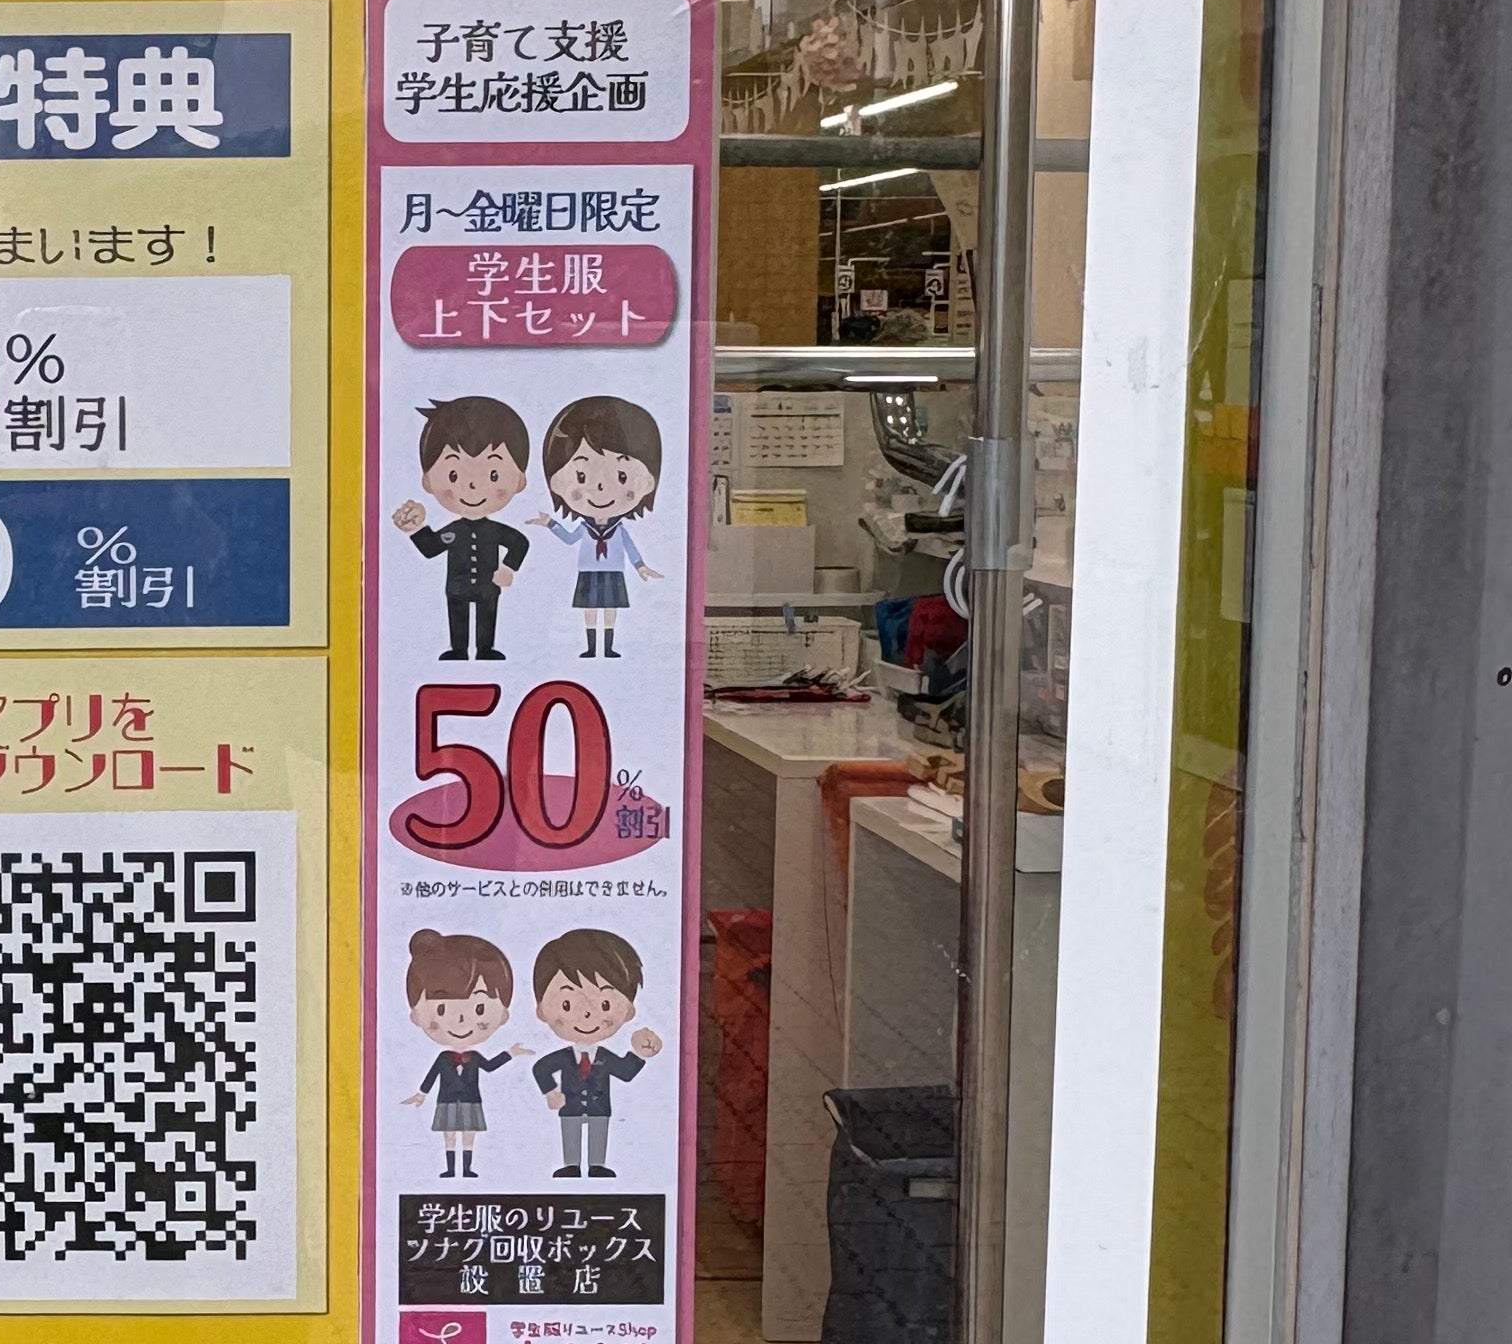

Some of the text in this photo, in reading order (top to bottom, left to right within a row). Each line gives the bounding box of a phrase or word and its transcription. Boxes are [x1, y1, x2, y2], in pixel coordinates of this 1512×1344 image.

[417, 19, 630, 63] 子育て支援
[395, 71, 649, 115] 学生応援企画
[466, 252, 607, 296] 学生服
[418, 298, 646, 340] 上下セット
[4, 395, 129, 453] 割引
[74, 565, 196, 610] 割引
[404, 679, 613, 850] 50
[615, 805, 671, 839] 割引
[417, 1202, 643, 1234] 学生服のリユース
[406, 1233, 657, 1265] ツナグ回収ボックス
